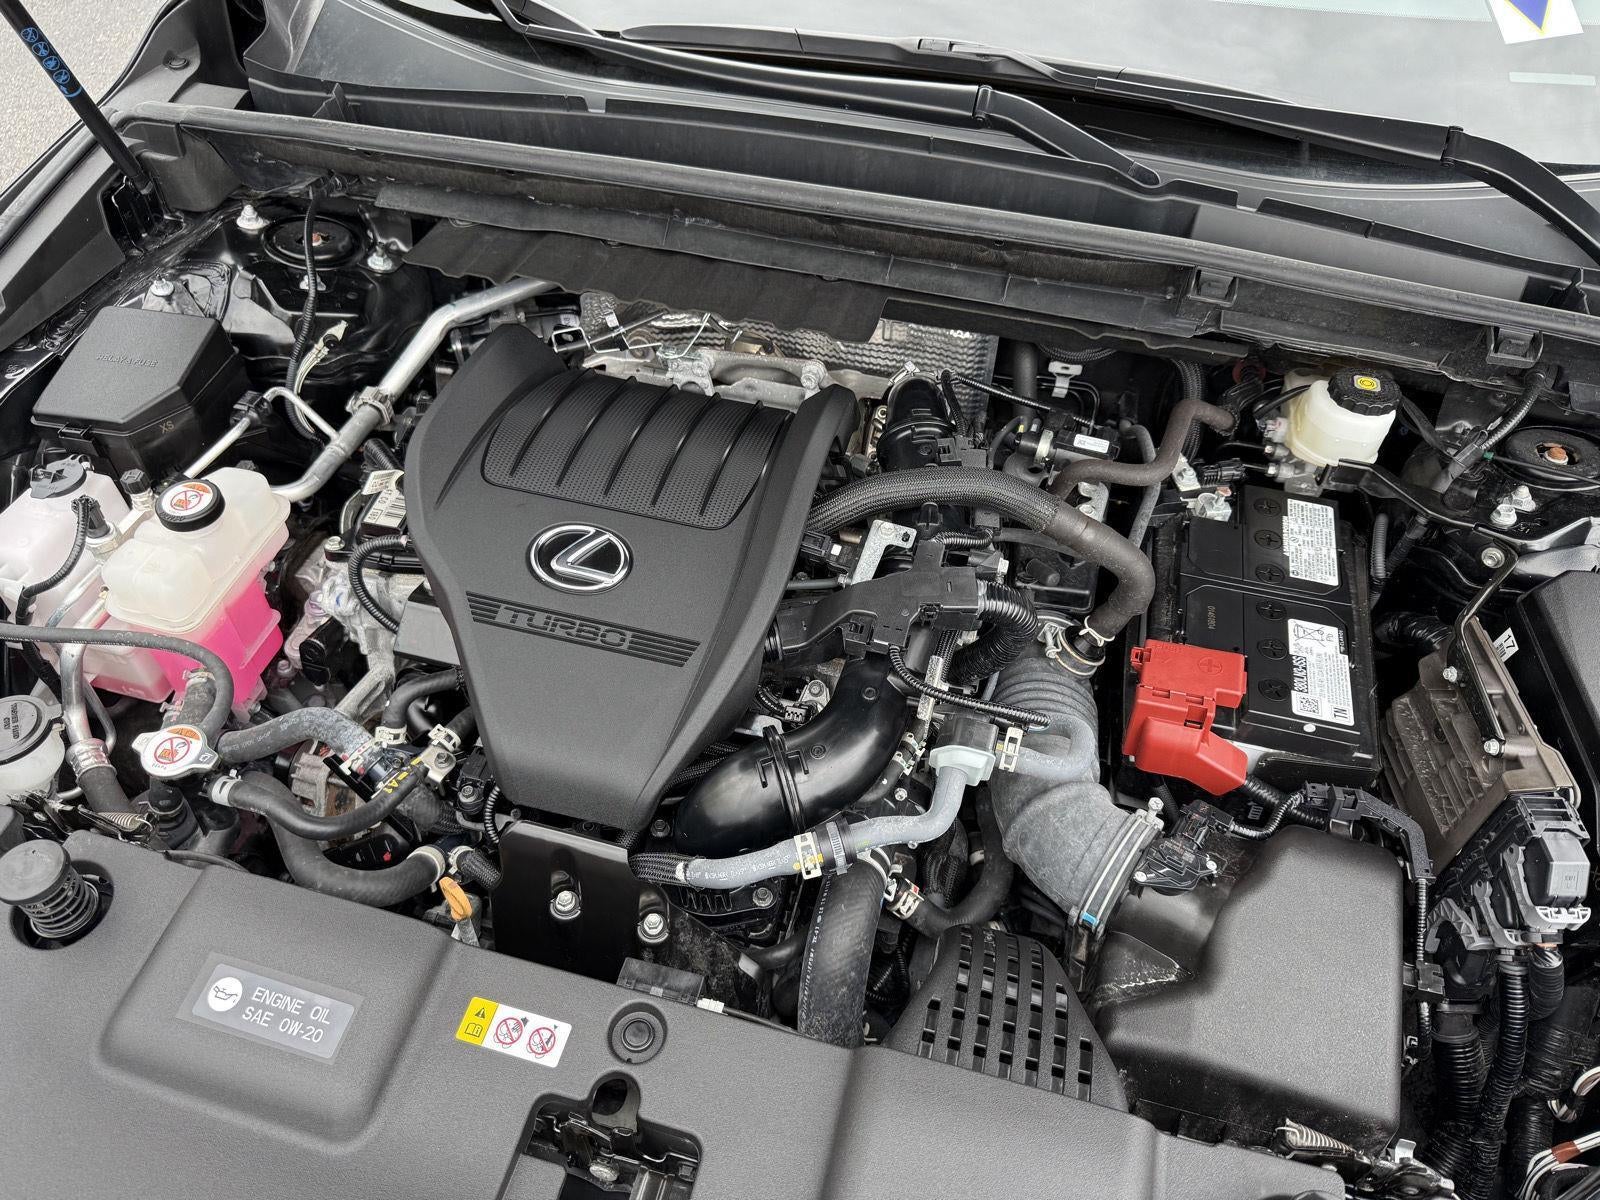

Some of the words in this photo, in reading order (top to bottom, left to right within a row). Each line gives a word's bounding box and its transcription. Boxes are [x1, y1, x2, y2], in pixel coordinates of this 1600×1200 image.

[504, 605, 627, 648] TURBO
[1503, 634, 1516, 649] 17
[242, 1006, 274, 1027] SAE
[279, 1018, 324, 1043] 0W-20
[252, 987, 305, 1015] ENGINE
[310, 1005, 331, 1025] OIL
